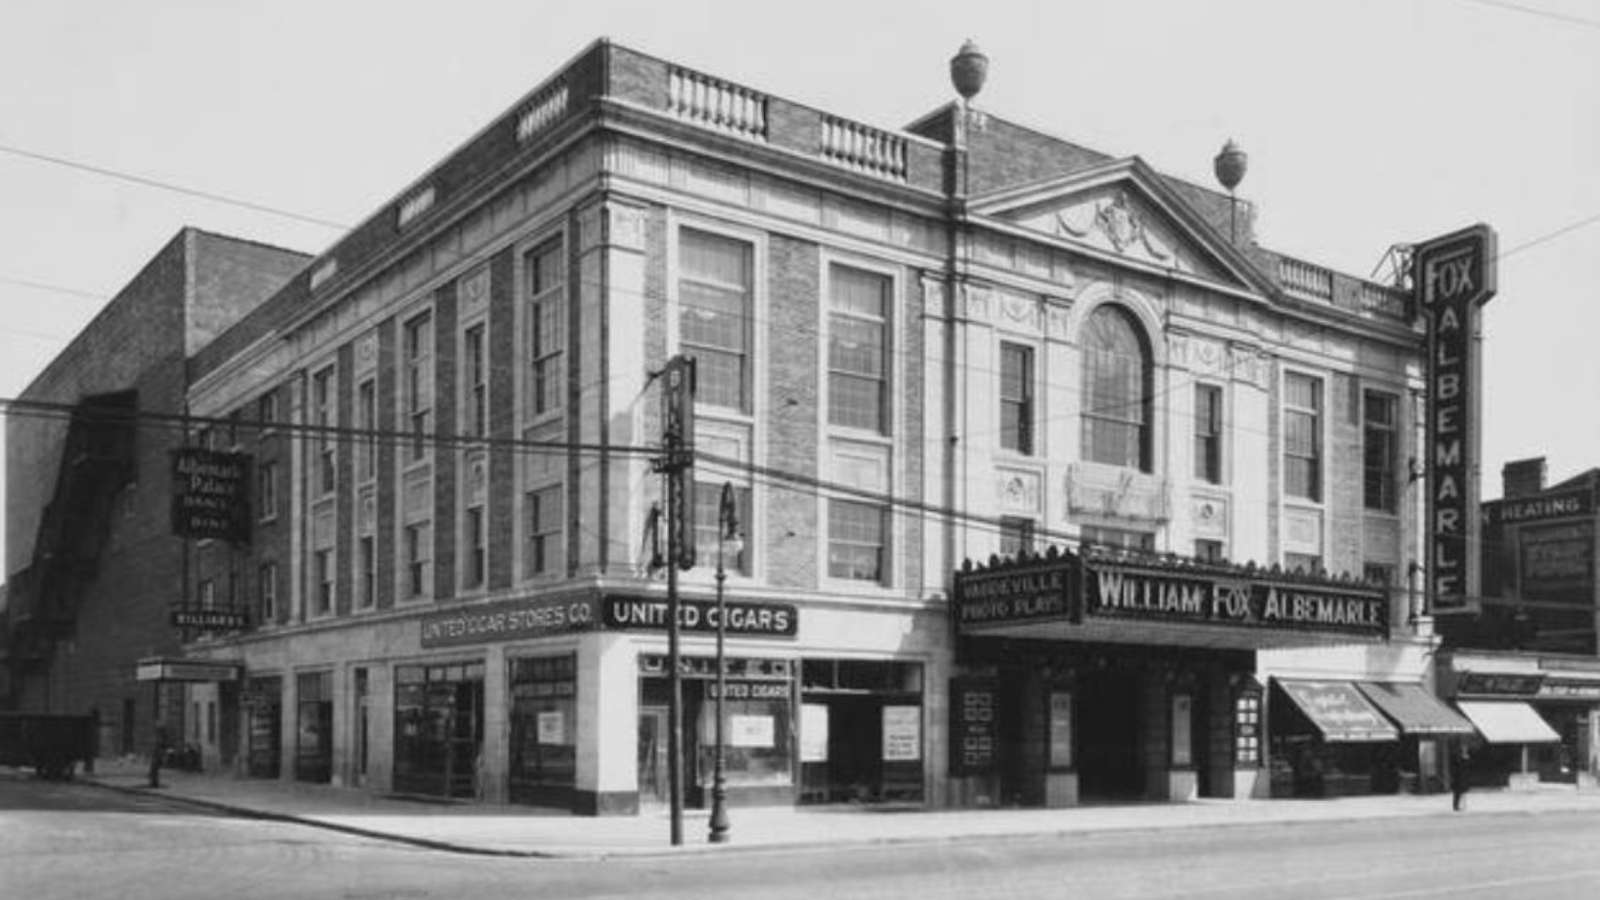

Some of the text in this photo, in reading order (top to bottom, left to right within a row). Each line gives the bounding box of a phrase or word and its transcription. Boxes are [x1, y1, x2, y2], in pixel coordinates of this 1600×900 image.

[1425, 246, 1474, 304] FOX
[1435, 305, 1459, 602] ALBEMARLE
[1501, 496, 1580, 520] HEATING
[422, 617, 466, 640] UNITED
[508, 605, 564, 630] STORES
[613, 601, 788, 632] UNITED CIGARS
